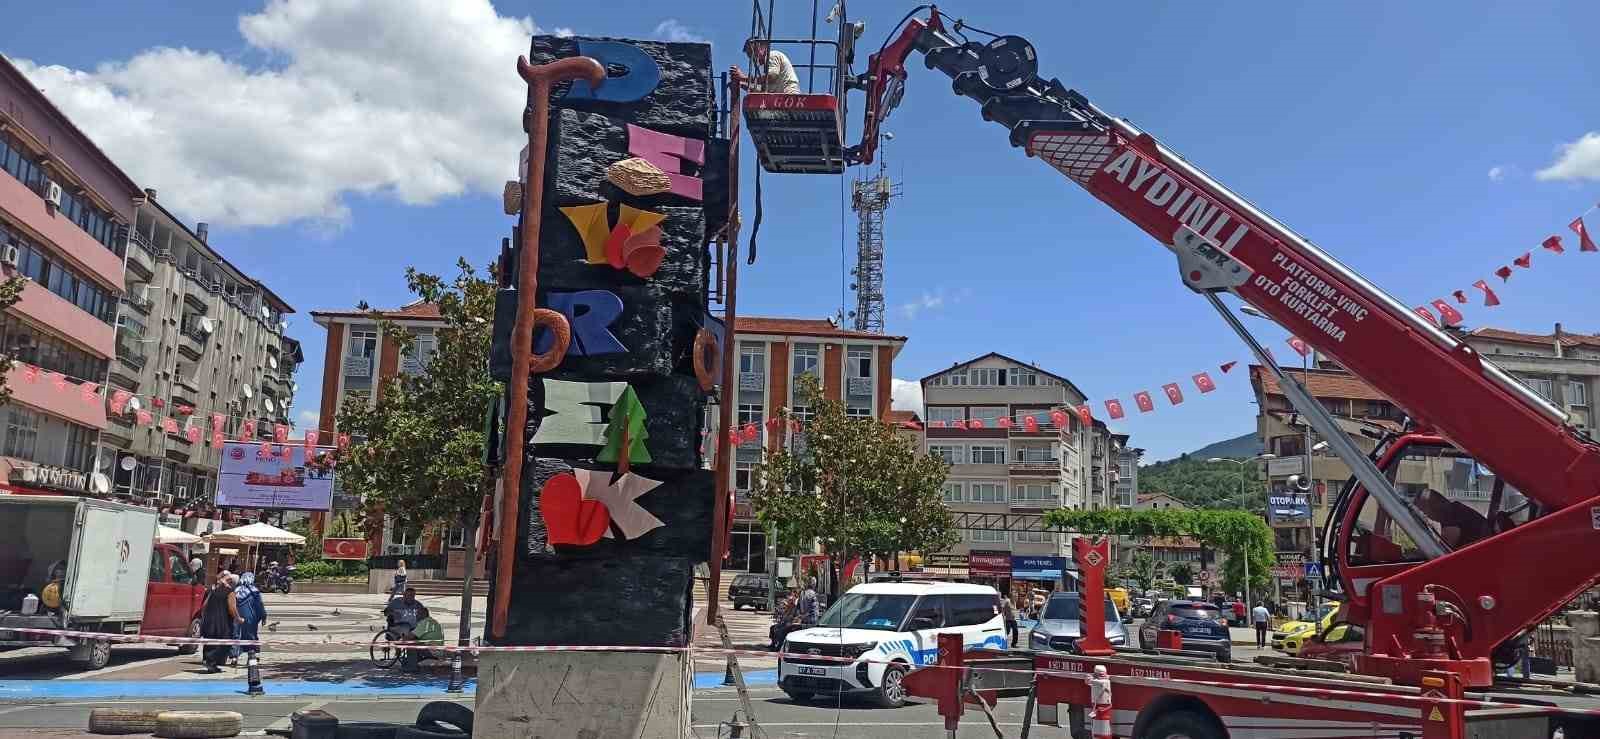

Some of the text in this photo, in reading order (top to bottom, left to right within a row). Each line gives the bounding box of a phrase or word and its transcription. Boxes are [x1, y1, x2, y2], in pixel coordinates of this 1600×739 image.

[1103, 149, 1249, 253] AYDINLI
[1254, 275, 1347, 342] OTO KURTARMA
[1270, 496, 1307, 506] OTOPARK
